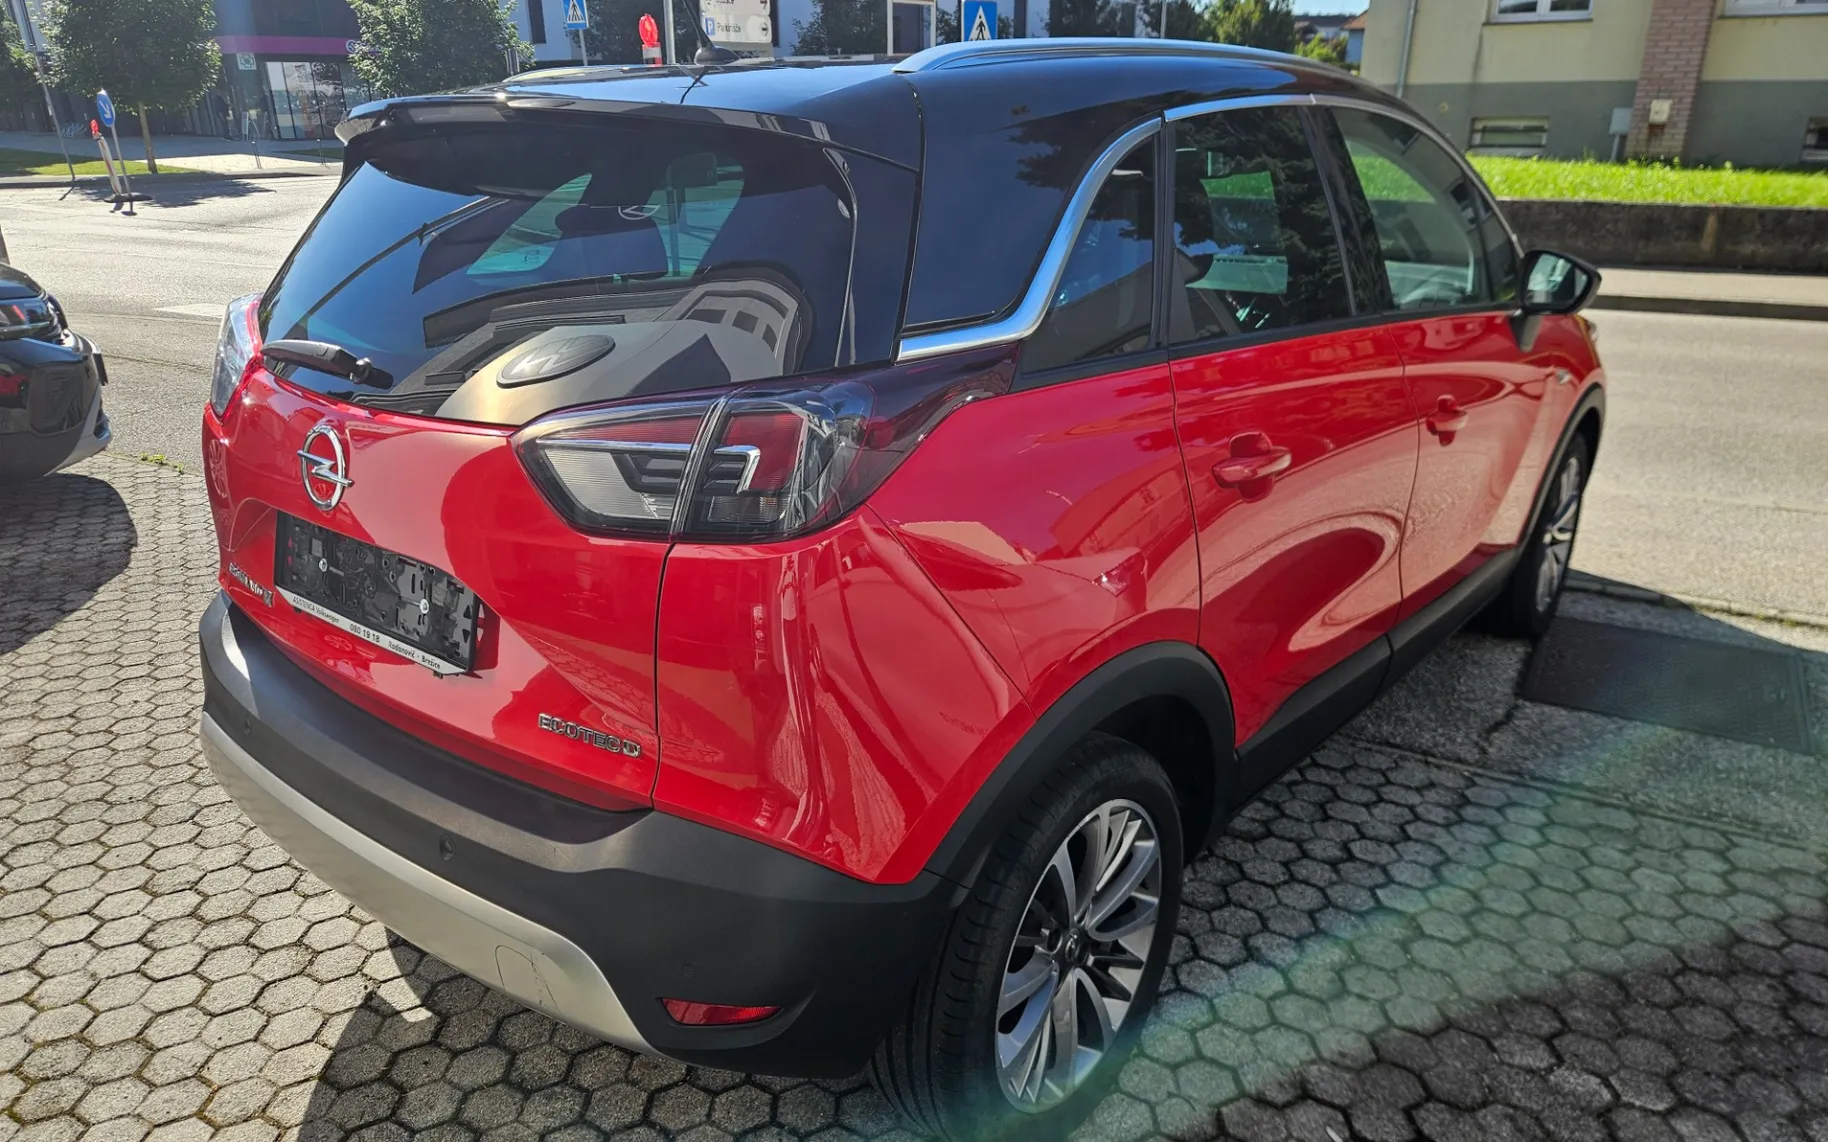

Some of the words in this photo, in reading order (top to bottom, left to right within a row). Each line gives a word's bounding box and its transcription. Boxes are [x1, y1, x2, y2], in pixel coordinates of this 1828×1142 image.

[350, 624, 361, 635] 080
[363, 629, 370, 639] 19
[372, 633, 380, 643] 18
[538, 712, 620, 753] ECOTEC
[622, 739, 641, 758] D
